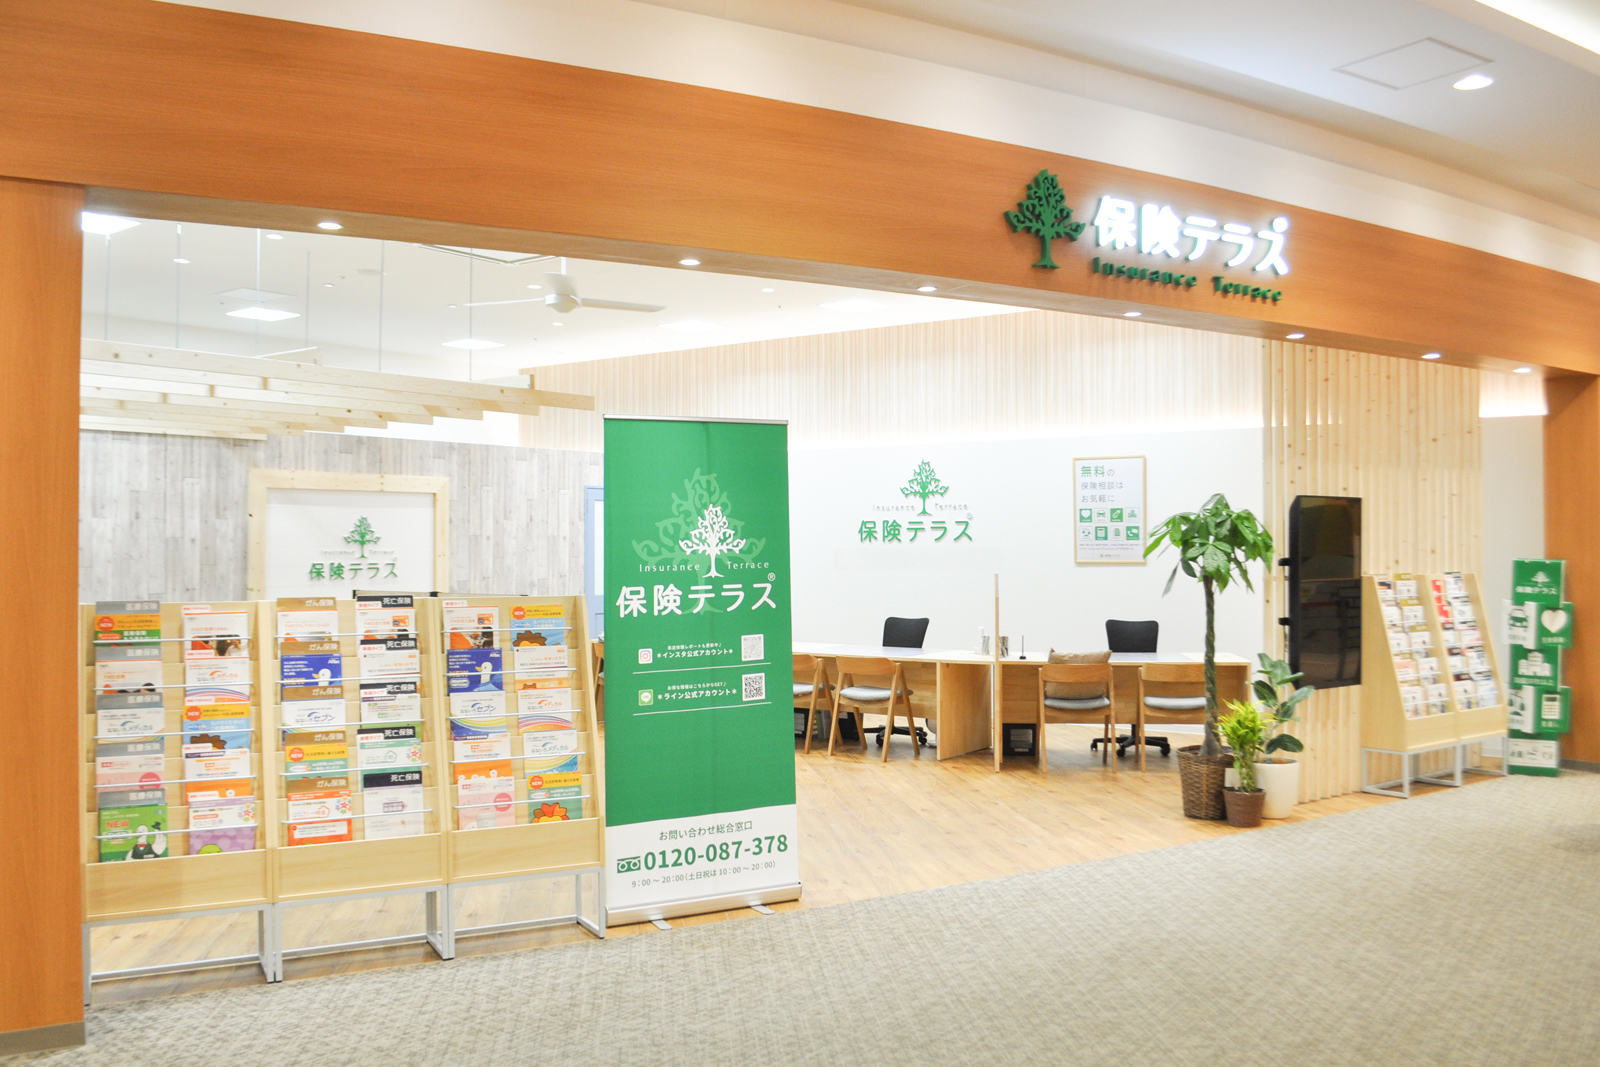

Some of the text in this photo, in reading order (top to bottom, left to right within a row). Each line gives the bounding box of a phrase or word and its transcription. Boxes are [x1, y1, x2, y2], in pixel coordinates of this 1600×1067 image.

[1091, 195, 1290, 275] 保険テラス
[1092, 257, 1283, 302] Insurance Terrace
[1081, 465, 1115, 478] 無料の
[935, 503, 968, 511] Terrace
[858, 519, 973, 543] 保険テラス
[309, 562, 398, 581] 保険テラス
[639, 561, 770, 573] Insurance Terrace
[615, 582, 777, 618] 保険テラス
[105, 820, 130, 828] NEW
[659, 820, 753, 841] お問い合わせ総合窓口
[643, 834, 788, 871] 0120-087-378
